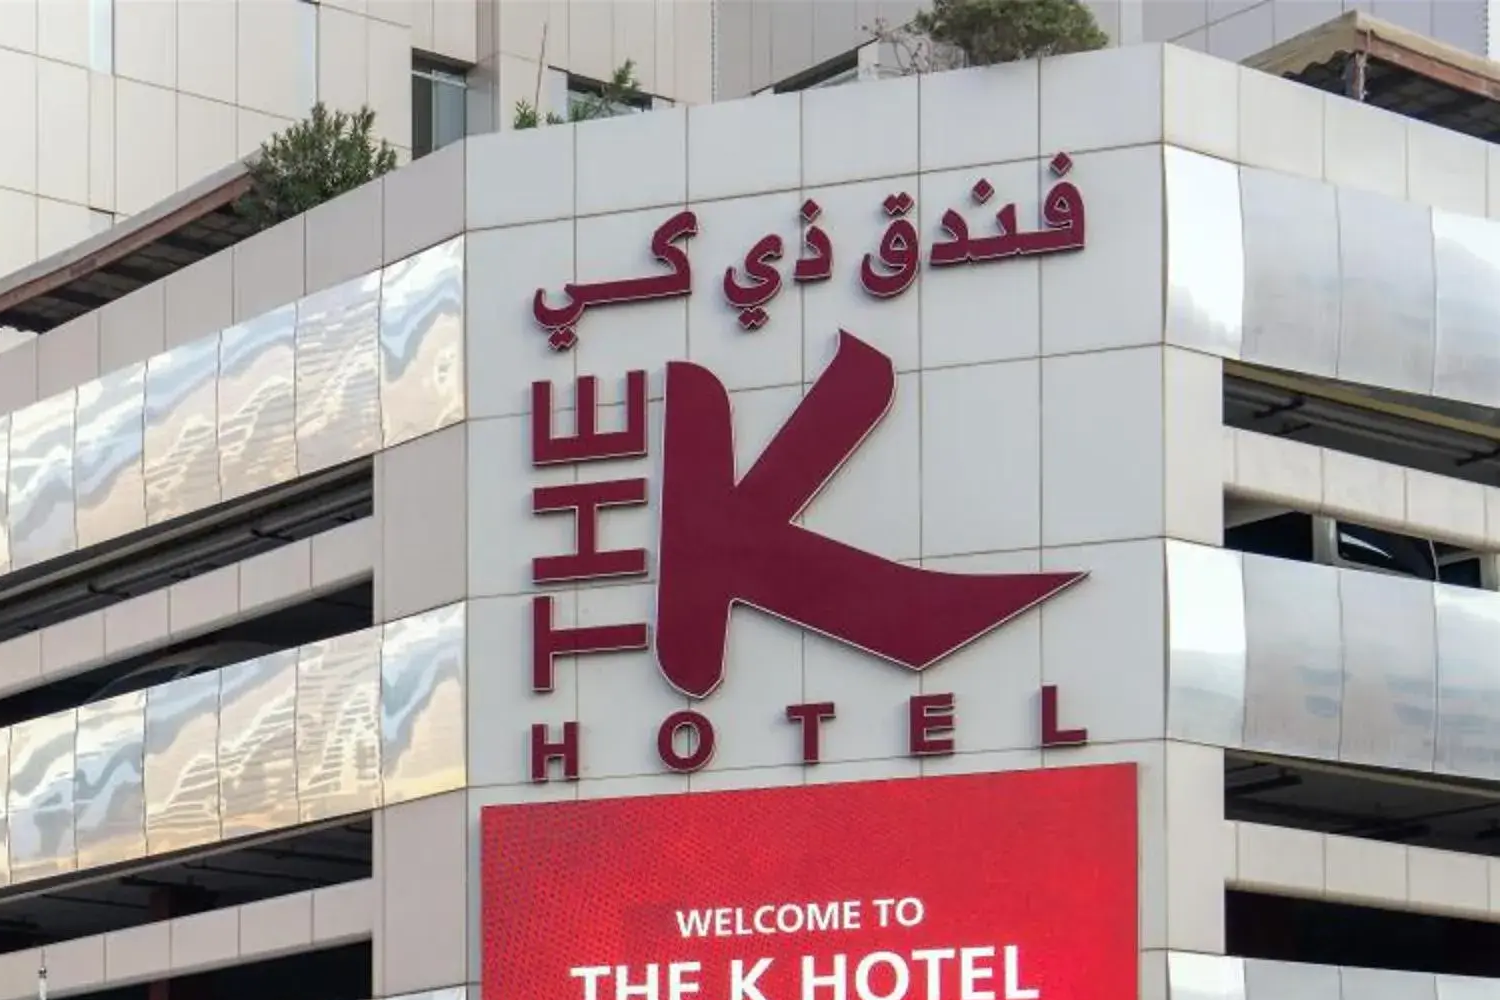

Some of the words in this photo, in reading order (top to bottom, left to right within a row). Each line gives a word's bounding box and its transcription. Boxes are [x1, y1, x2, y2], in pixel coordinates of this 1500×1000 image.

[531, 209, 699, 351] كي
[723, 199, 834, 330] ذي
[861, 152, 1087, 298] فندق
[531, 369, 648, 695] THE
[654, 327, 1091, 699] K
[531, 685, 1088, 783] HOTEL
[676, 900, 861, 938] WELCOME
[872, 896, 926, 929] TO
